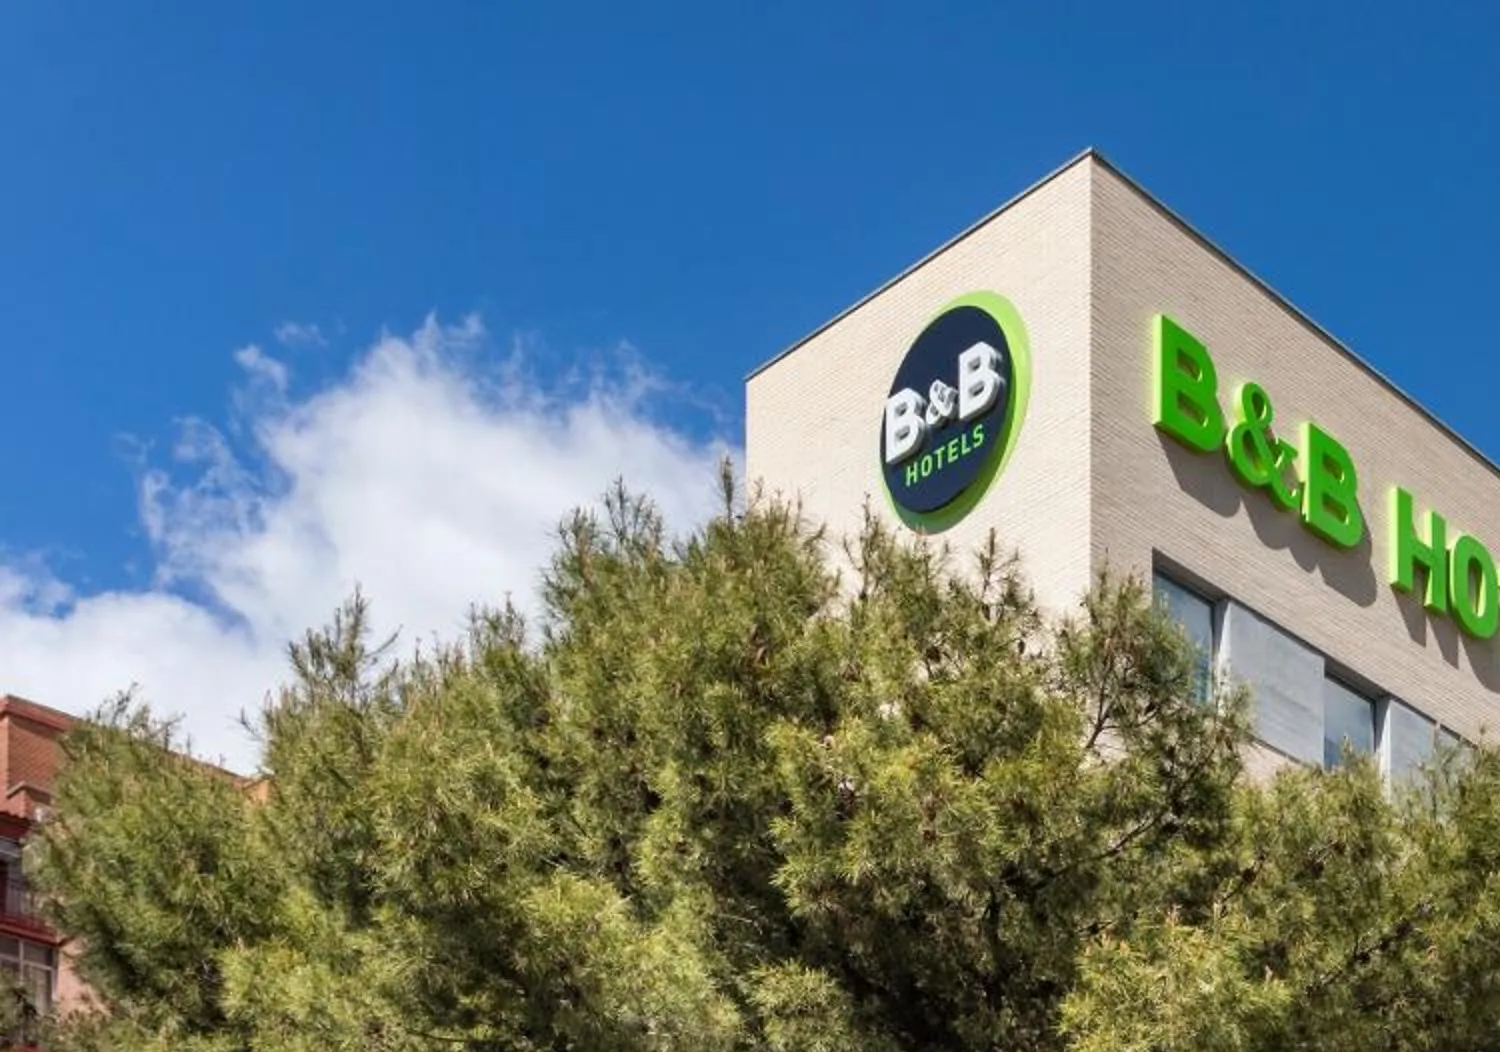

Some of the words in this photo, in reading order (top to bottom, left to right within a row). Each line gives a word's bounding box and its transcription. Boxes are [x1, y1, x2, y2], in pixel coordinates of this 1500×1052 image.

[884, 341, 1005, 464] B&B
[905, 423, 985, 487] HOTELS
[1152, 314, 1362, 548] B&B
